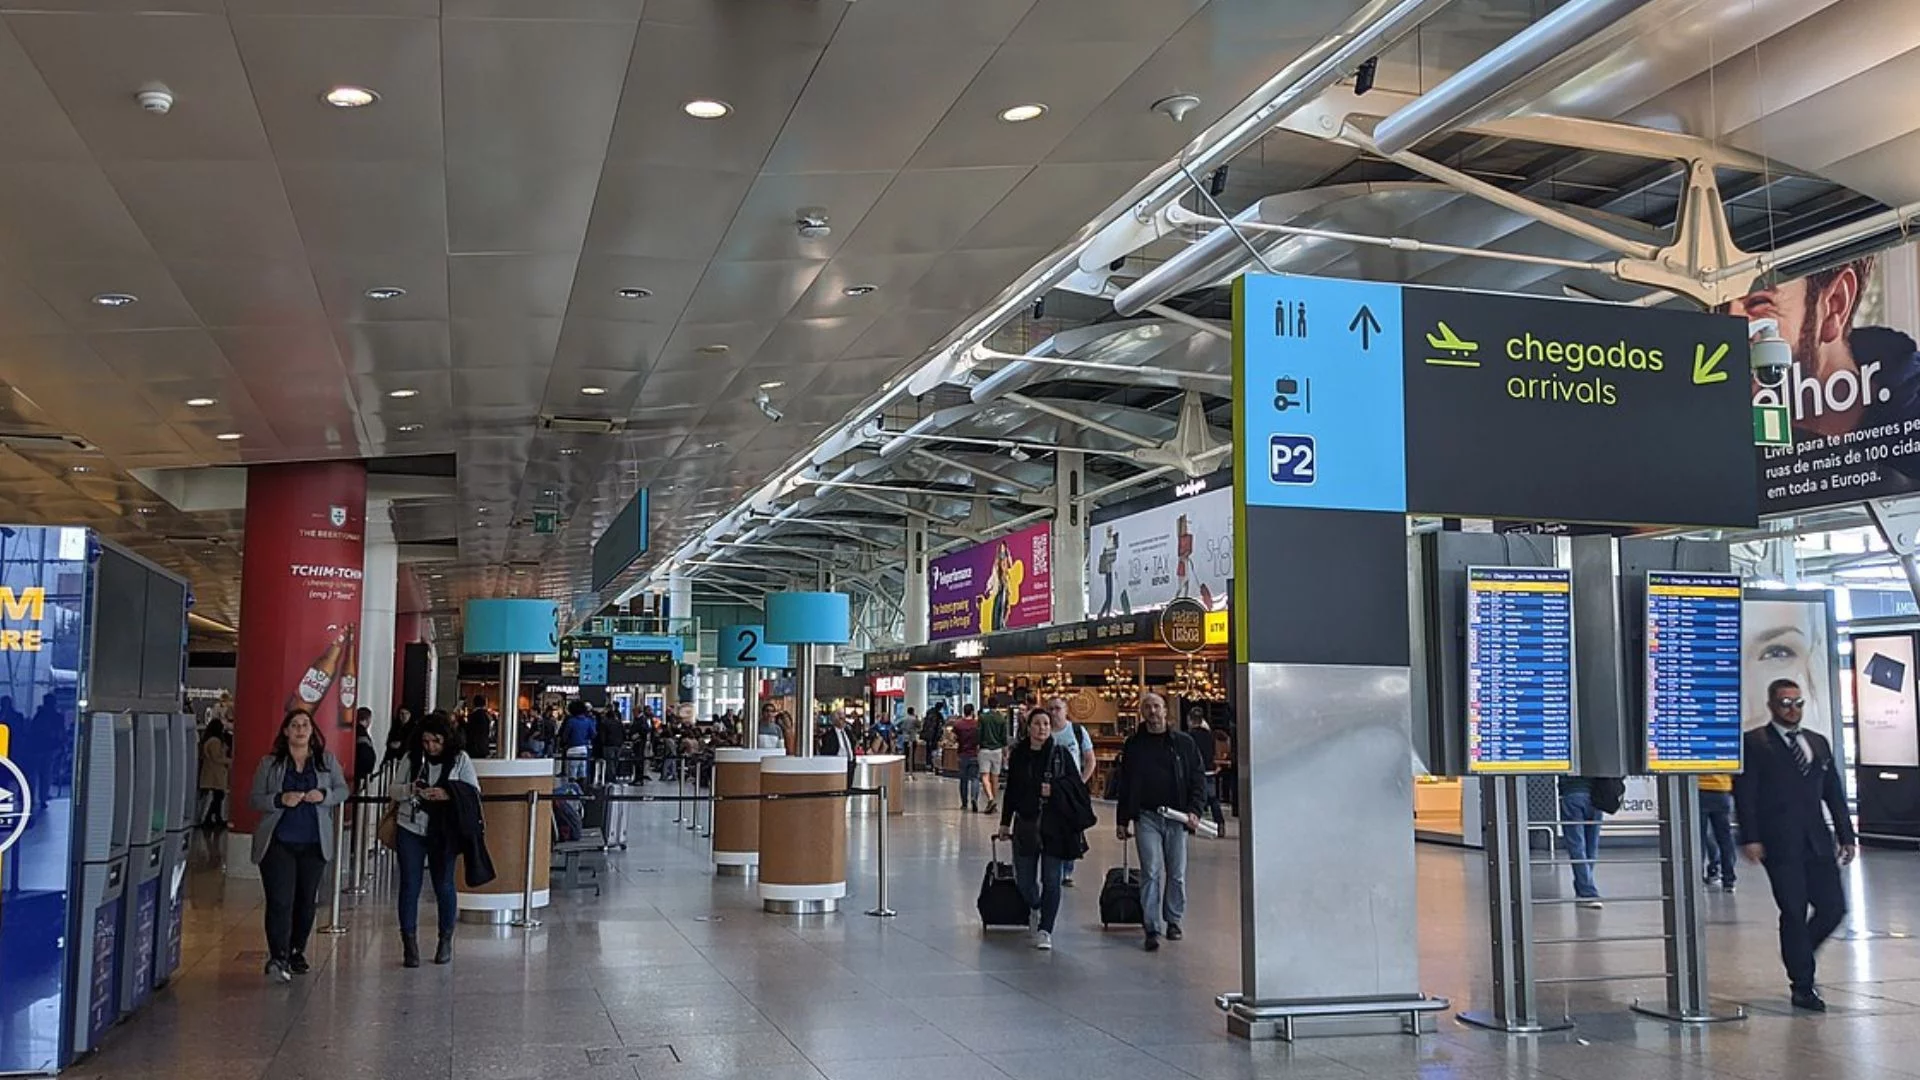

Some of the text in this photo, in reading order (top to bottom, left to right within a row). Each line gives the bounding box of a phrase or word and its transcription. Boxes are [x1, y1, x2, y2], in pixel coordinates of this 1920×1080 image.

[1506, 332, 1664, 372] chegadas
[1507, 373, 1617, 405] arrivals
[1797, 438, 1824, 456] para
[1827, 434, 1840, 447] te
[1844, 425, 1900, 444] moveres
[1272, 444, 1313, 476] P2
[1766, 464, 1790, 479] ruas
[1793, 460, 1810, 474] de
[1813, 454, 1842, 470] mais
[1845, 449, 1861, 464] de
[1865, 445, 1888, 461] 100
[1767, 470, 1881, 498] em toda a Europa.
[738, 630, 757, 662] 2
[546, 685, 580, 694] STARBU
[1620, 799, 1653, 811] care
